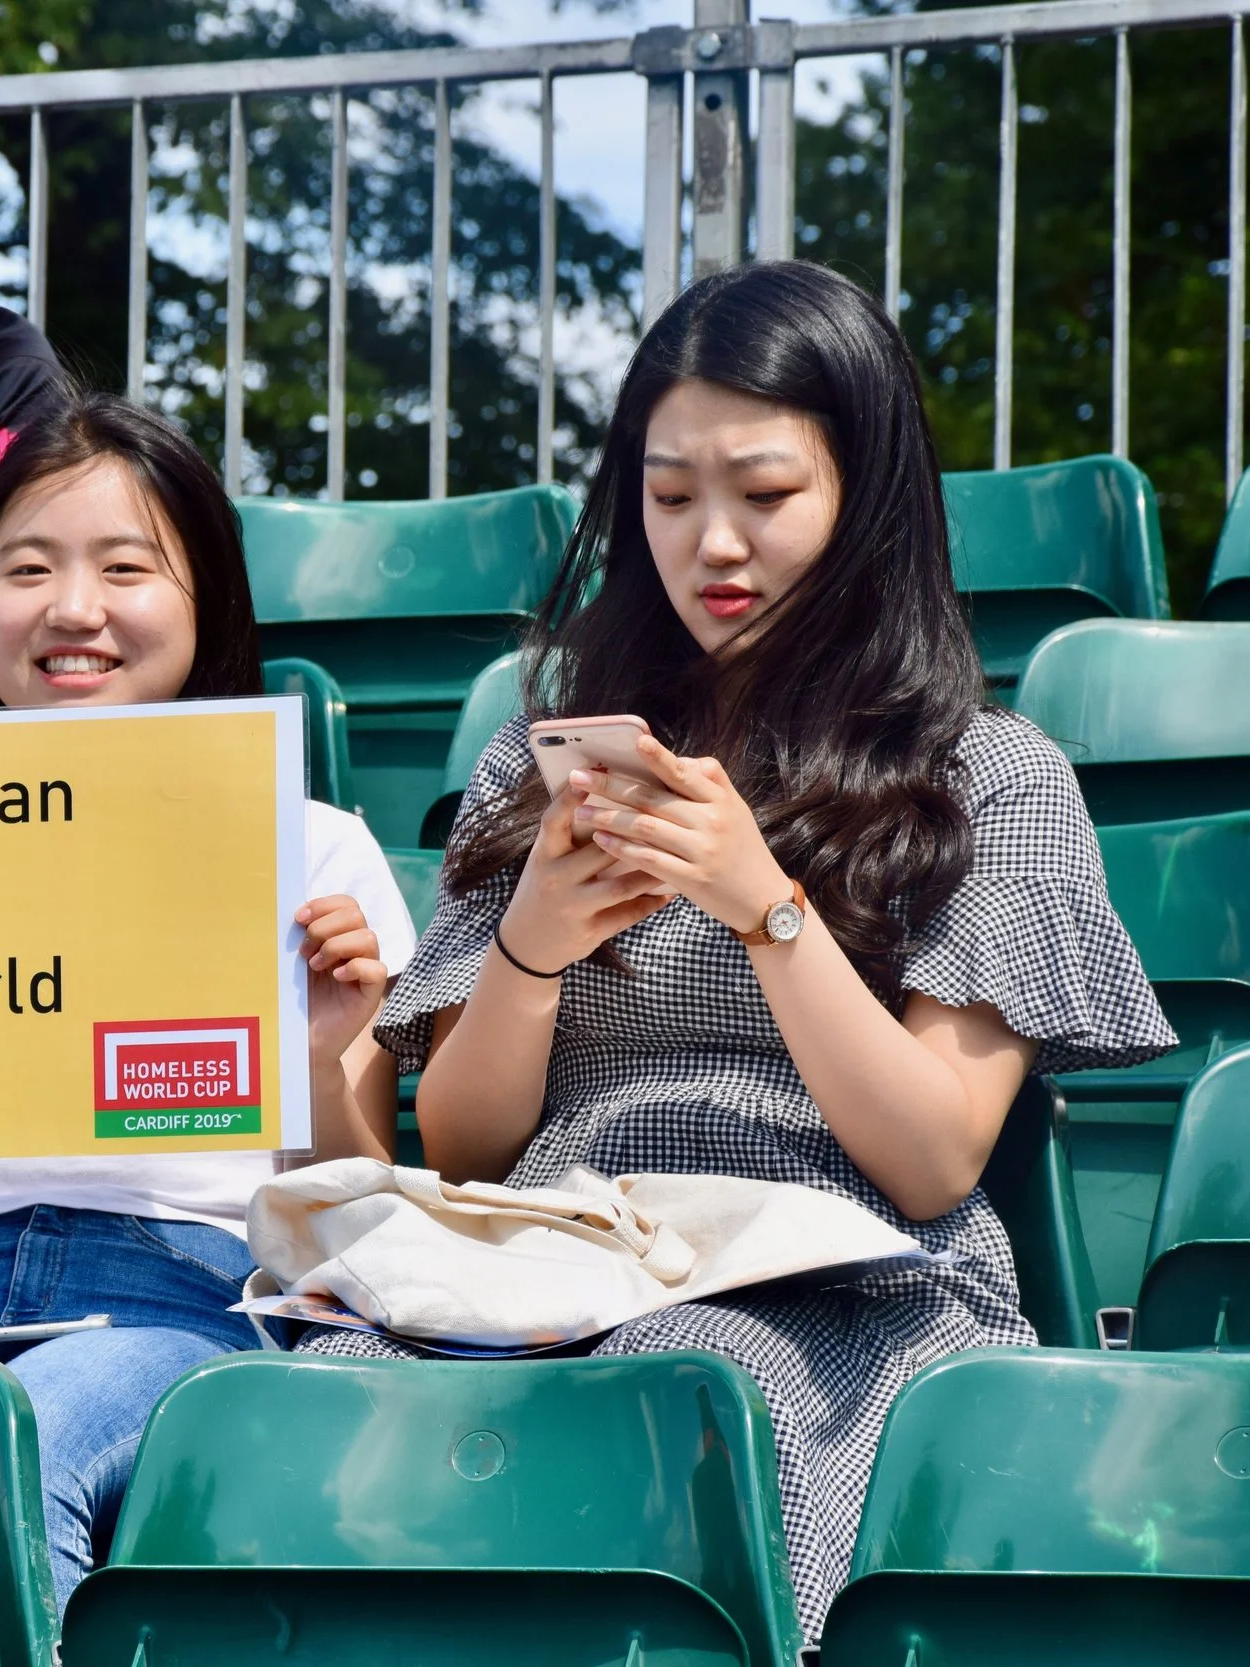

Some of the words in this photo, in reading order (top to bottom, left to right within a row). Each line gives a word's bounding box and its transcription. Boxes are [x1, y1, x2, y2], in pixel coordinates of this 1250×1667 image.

[123, 1059, 231, 1080] HOMELESS
[123, 1081, 189, 1100] WORLD
[193, 1080, 231, 1098] CUP
[124, 1115, 190, 1131] CARDIFF
[194, 1113, 233, 1129] 2019
